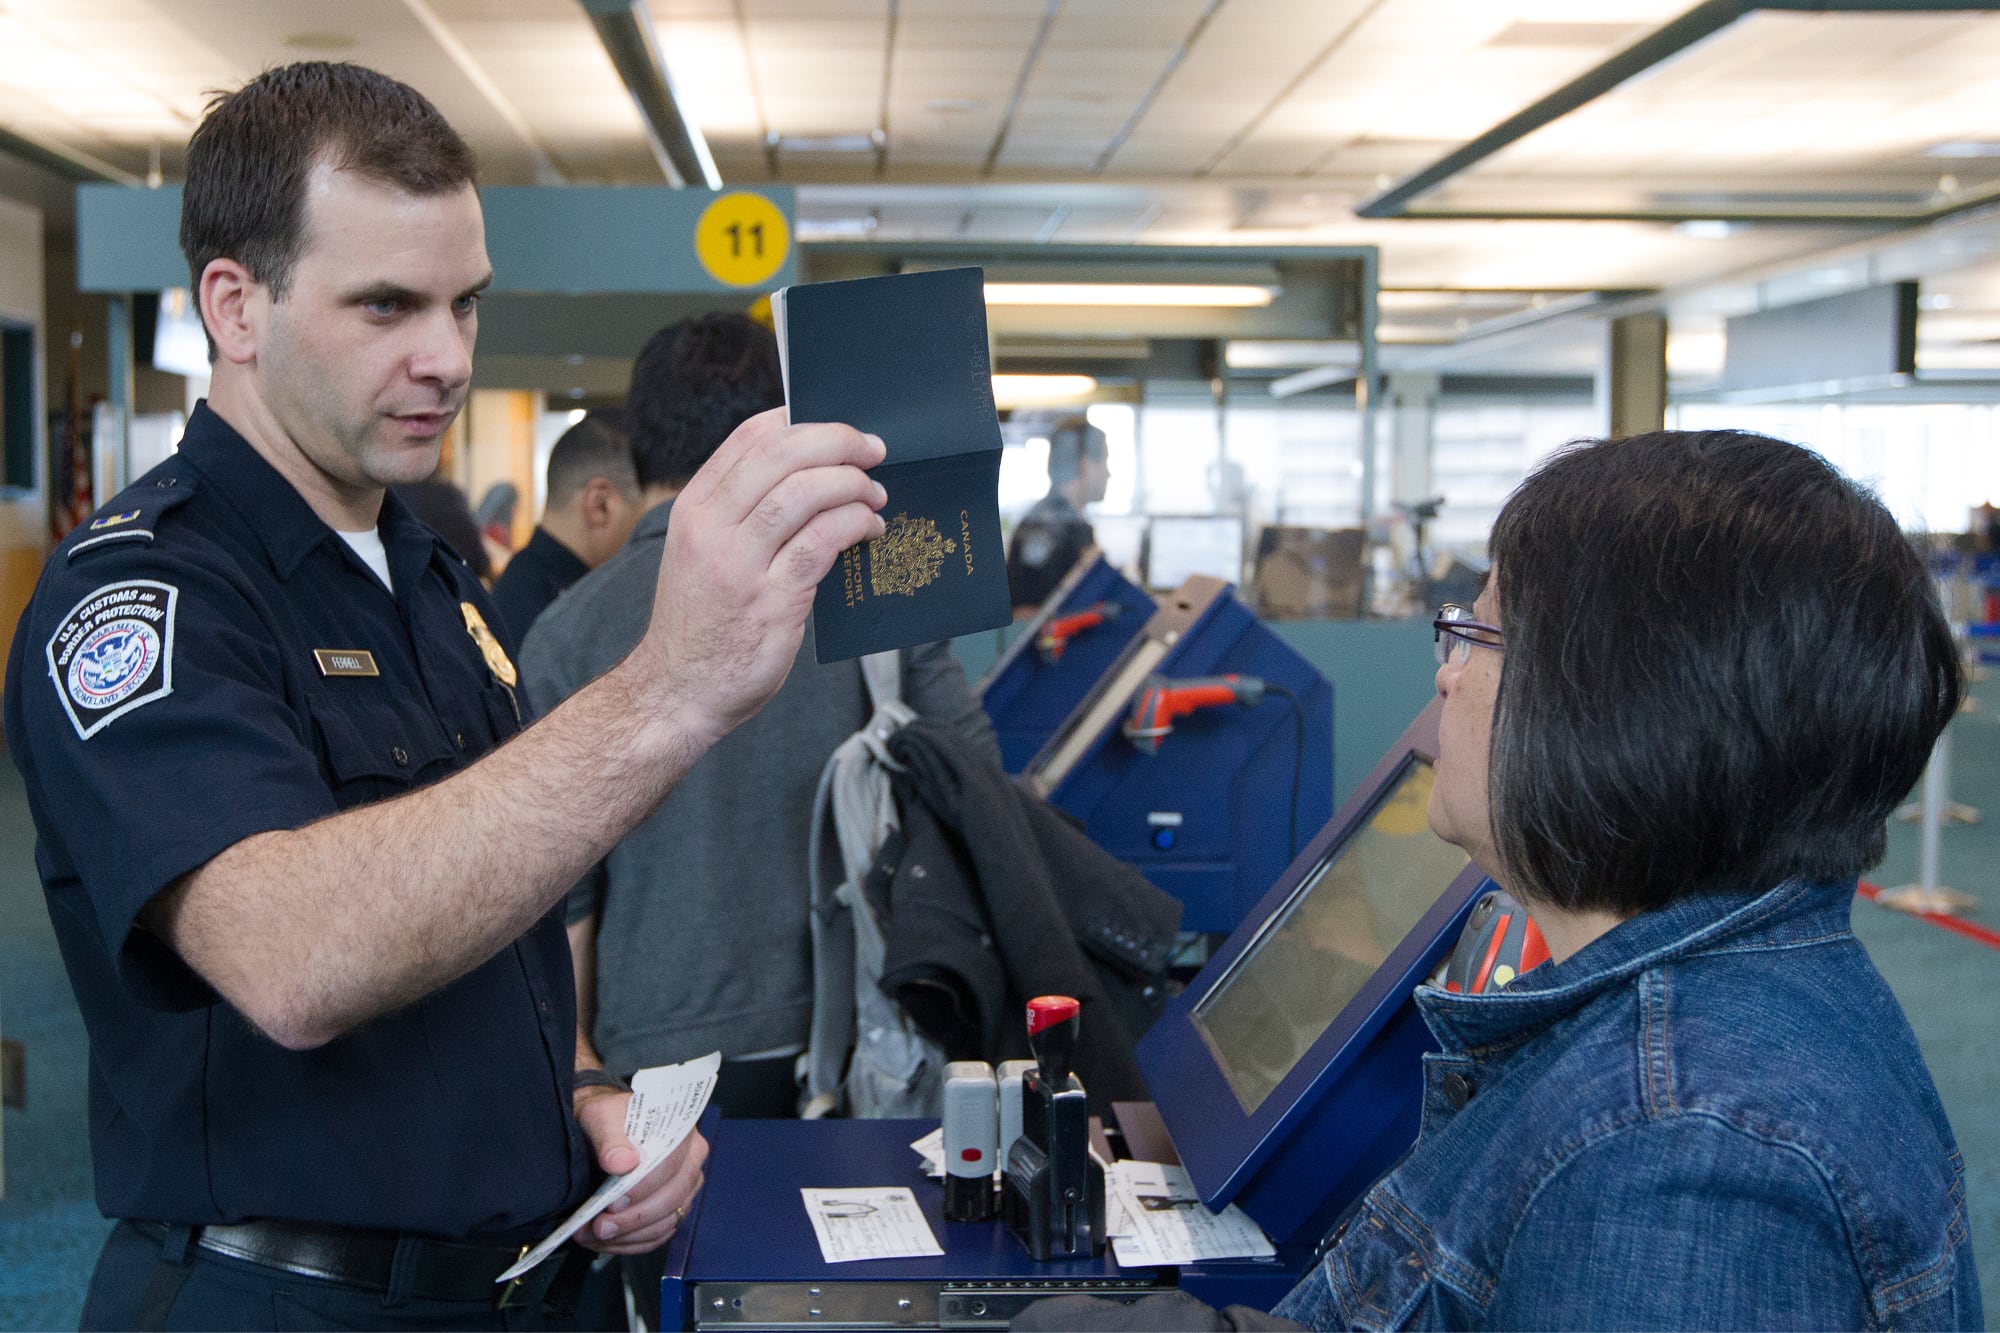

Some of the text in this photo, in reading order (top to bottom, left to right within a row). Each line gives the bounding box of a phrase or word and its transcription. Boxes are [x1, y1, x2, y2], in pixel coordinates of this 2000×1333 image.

[722, 221, 764, 258] 11
[960, 509, 974, 576] CANADA
[843, 550, 855, 608] SEPORT
[853, 545, 865, 602] SSPORT
[58, 604, 165, 665] BORDER PROTECTION
[59, 589, 157, 643] U.S. CUSTOMS AND
[73, 649, 156, 705] HOMELAND SECURITY
[331, 656, 363, 669] FERRELL
